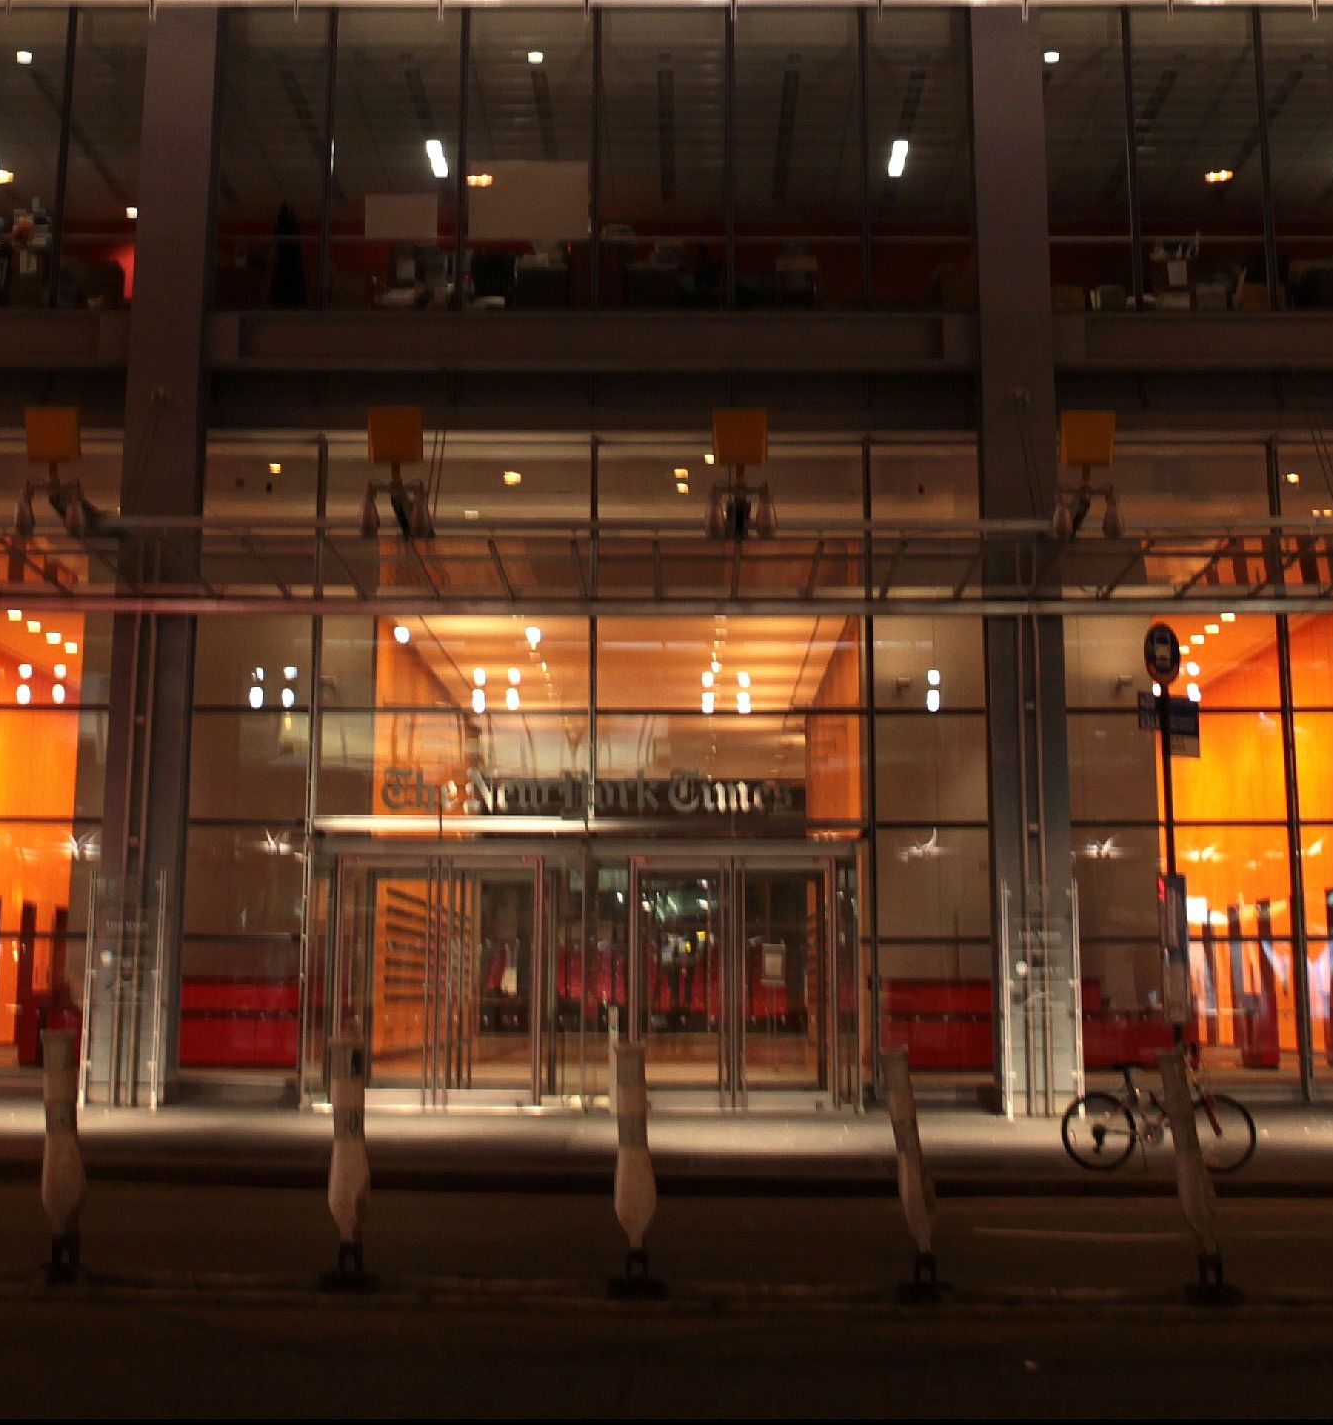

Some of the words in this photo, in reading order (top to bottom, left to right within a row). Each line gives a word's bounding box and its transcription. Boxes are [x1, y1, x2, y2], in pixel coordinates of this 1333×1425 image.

[381, 765, 458, 812] The
[463, 765, 553, 814] New
[668, 767, 795, 813] Times
